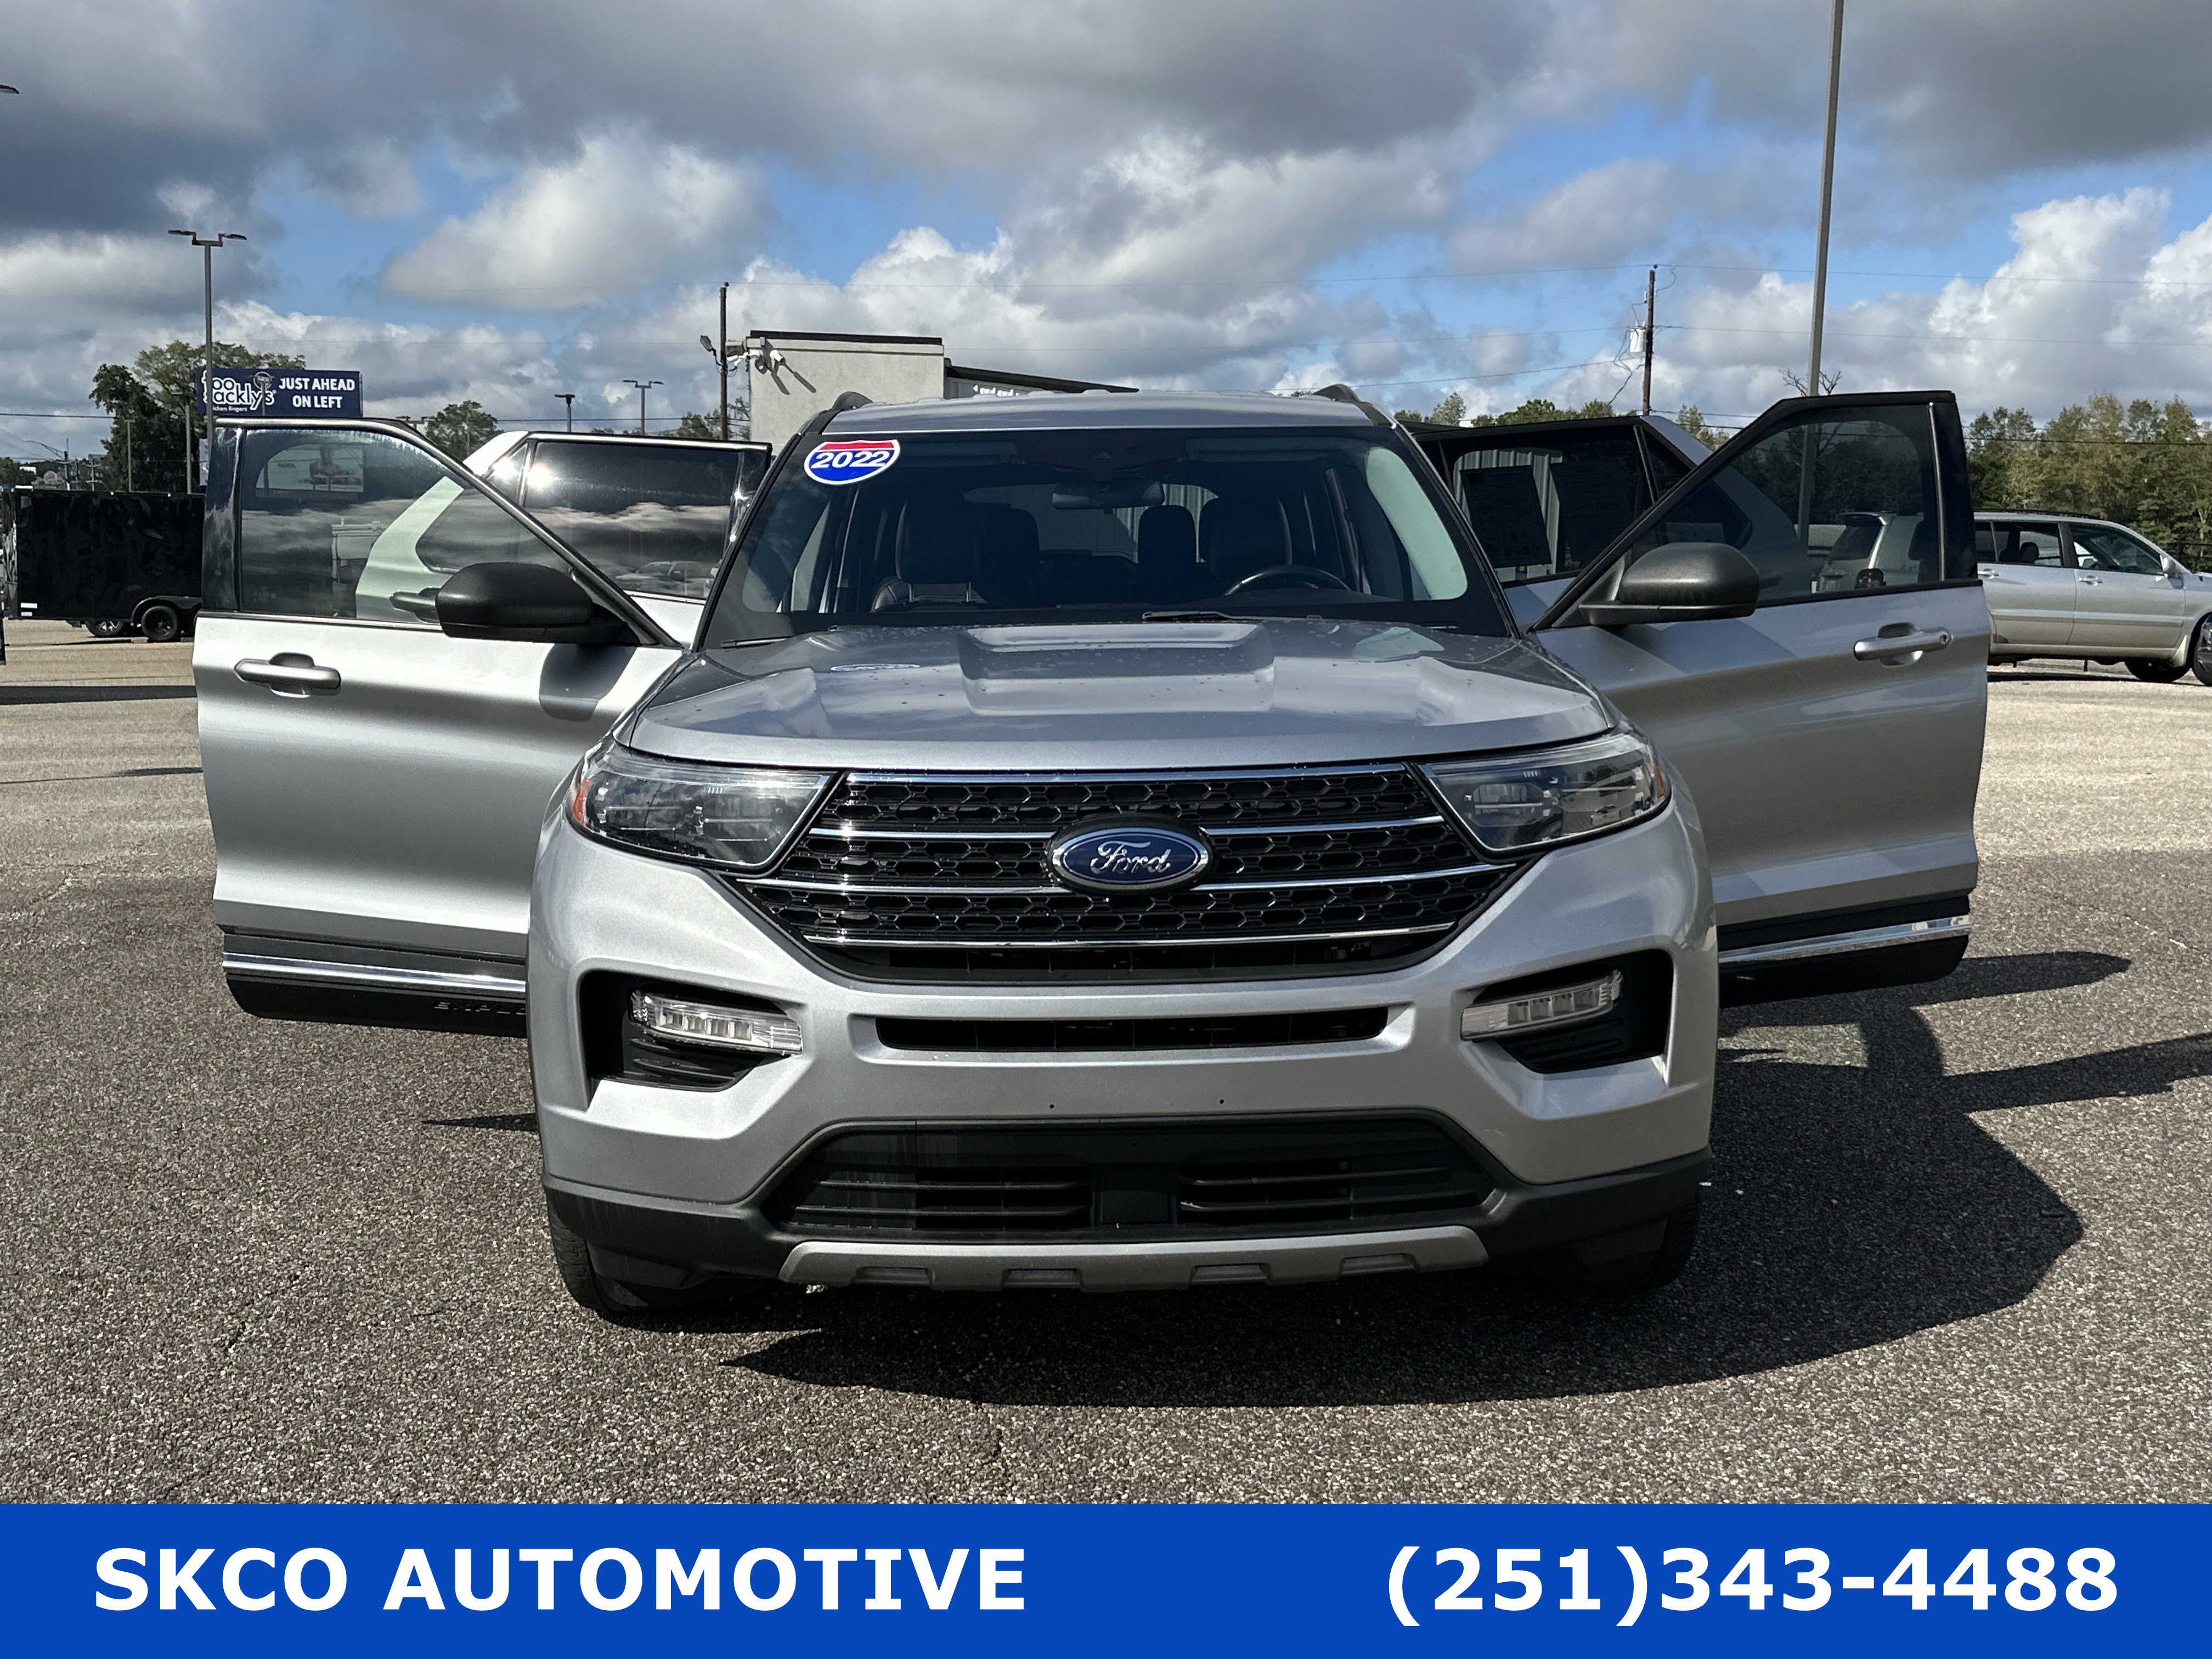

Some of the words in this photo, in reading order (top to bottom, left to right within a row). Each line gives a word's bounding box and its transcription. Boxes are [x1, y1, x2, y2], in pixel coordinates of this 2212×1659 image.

[279, 377, 310, 390] JUST
[312, 378, 355, 391] AHEAD
[292, 395, 311, 407] ON
[314, 396, 342, 408] LEFT
[810, 451, 890, 469] 2022
[1090, 840, 1171, 874] Ford
